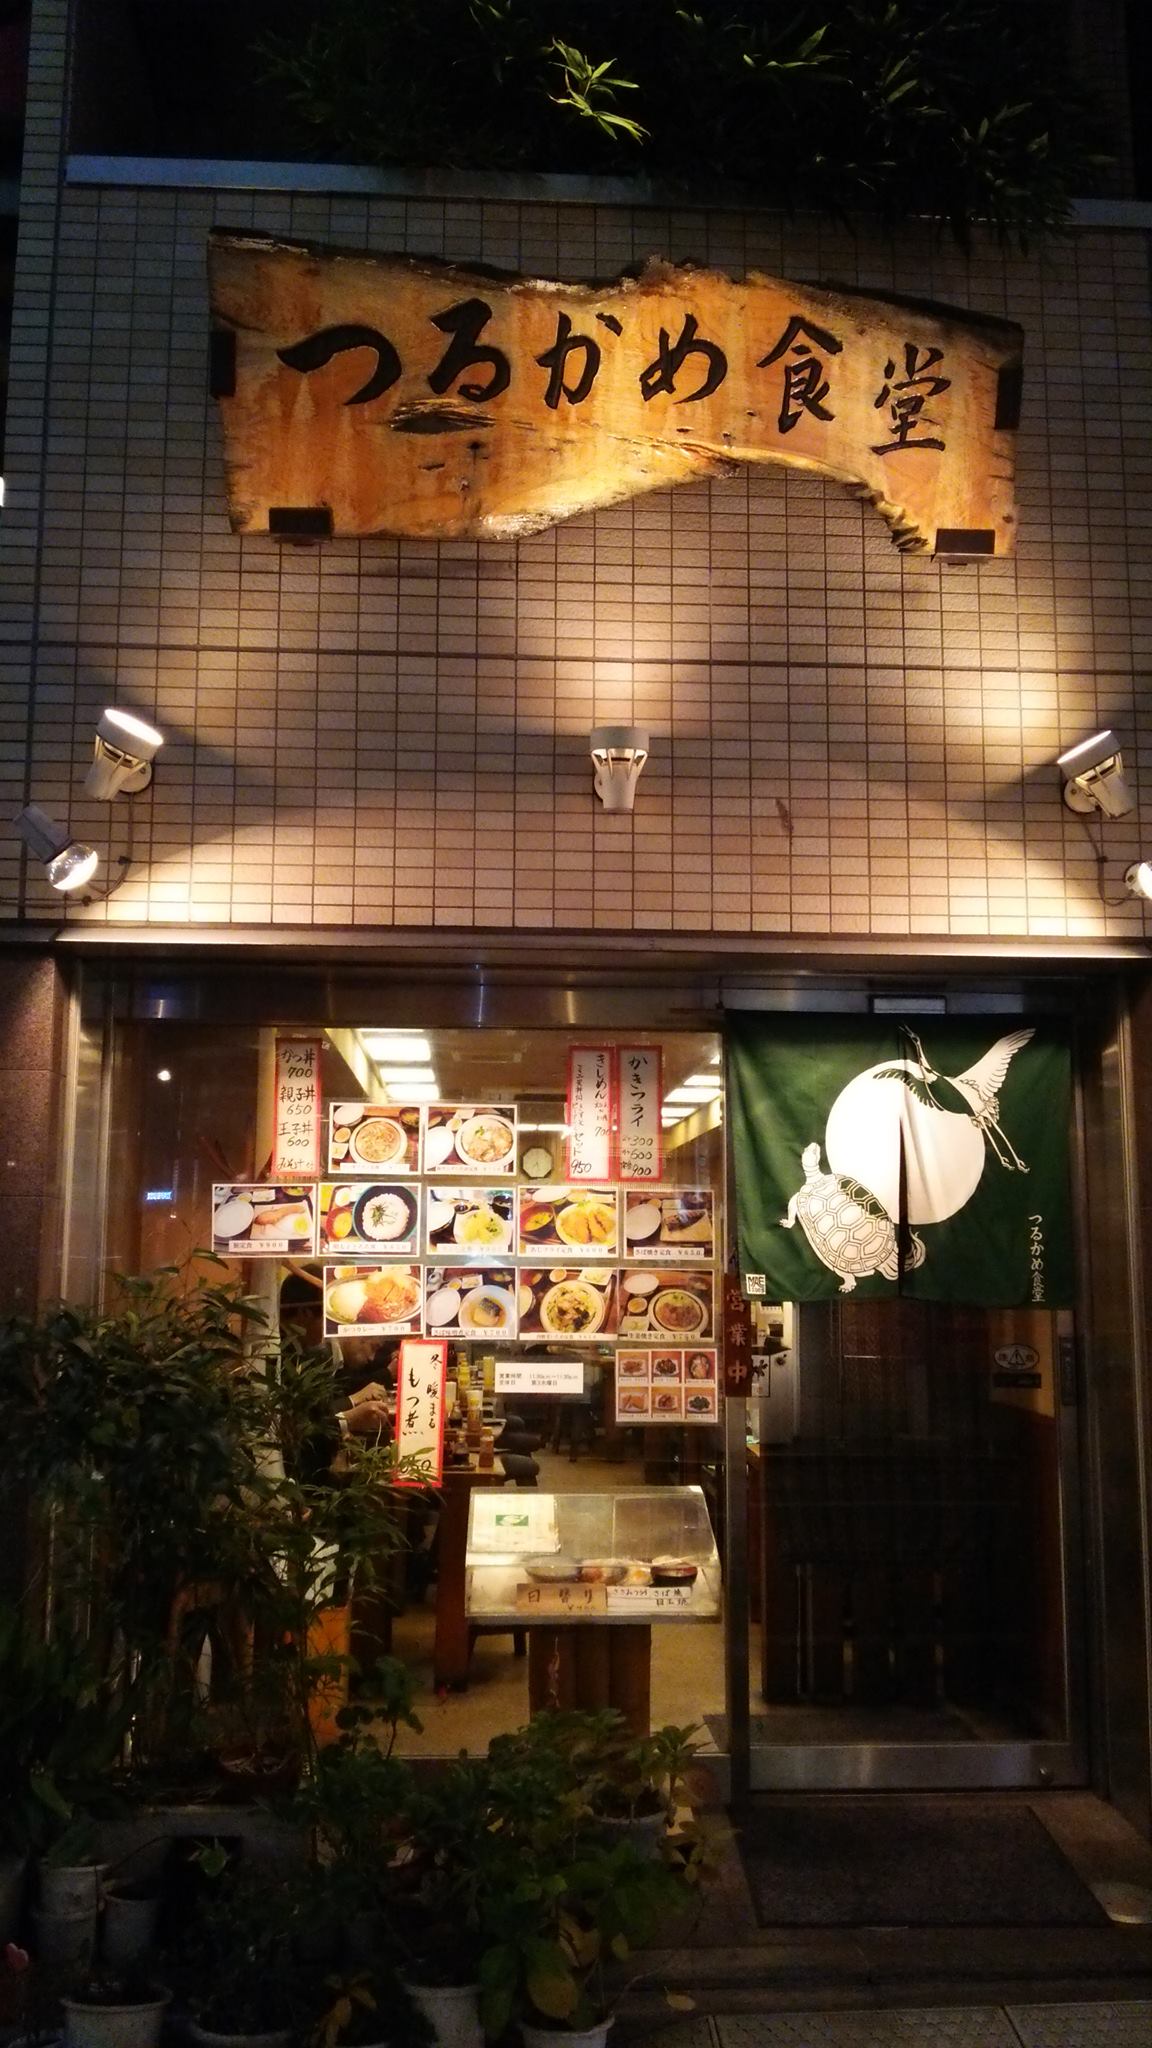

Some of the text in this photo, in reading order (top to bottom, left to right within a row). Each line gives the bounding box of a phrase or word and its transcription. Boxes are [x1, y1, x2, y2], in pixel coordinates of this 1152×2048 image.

[277, 297, 951, 456] つるかめ食堂
[288, 1067, 313, 1078] 700
[594, 1053, 608, 1100] きしめん
[628, 1056, 649, 1127] かきフライ
[287, 1104, 312, 1116] 650
[630, 1135, 654, 1147] 300
[630, 1148, 653, 1160] 600
[571, 1159, 592, 1174] 950
[631, 1163, 653, 1177] 900
[1028, 1214, 1046, 1302] つるかめ食堂
[402, 1367, 424, 1436] もつ煮
